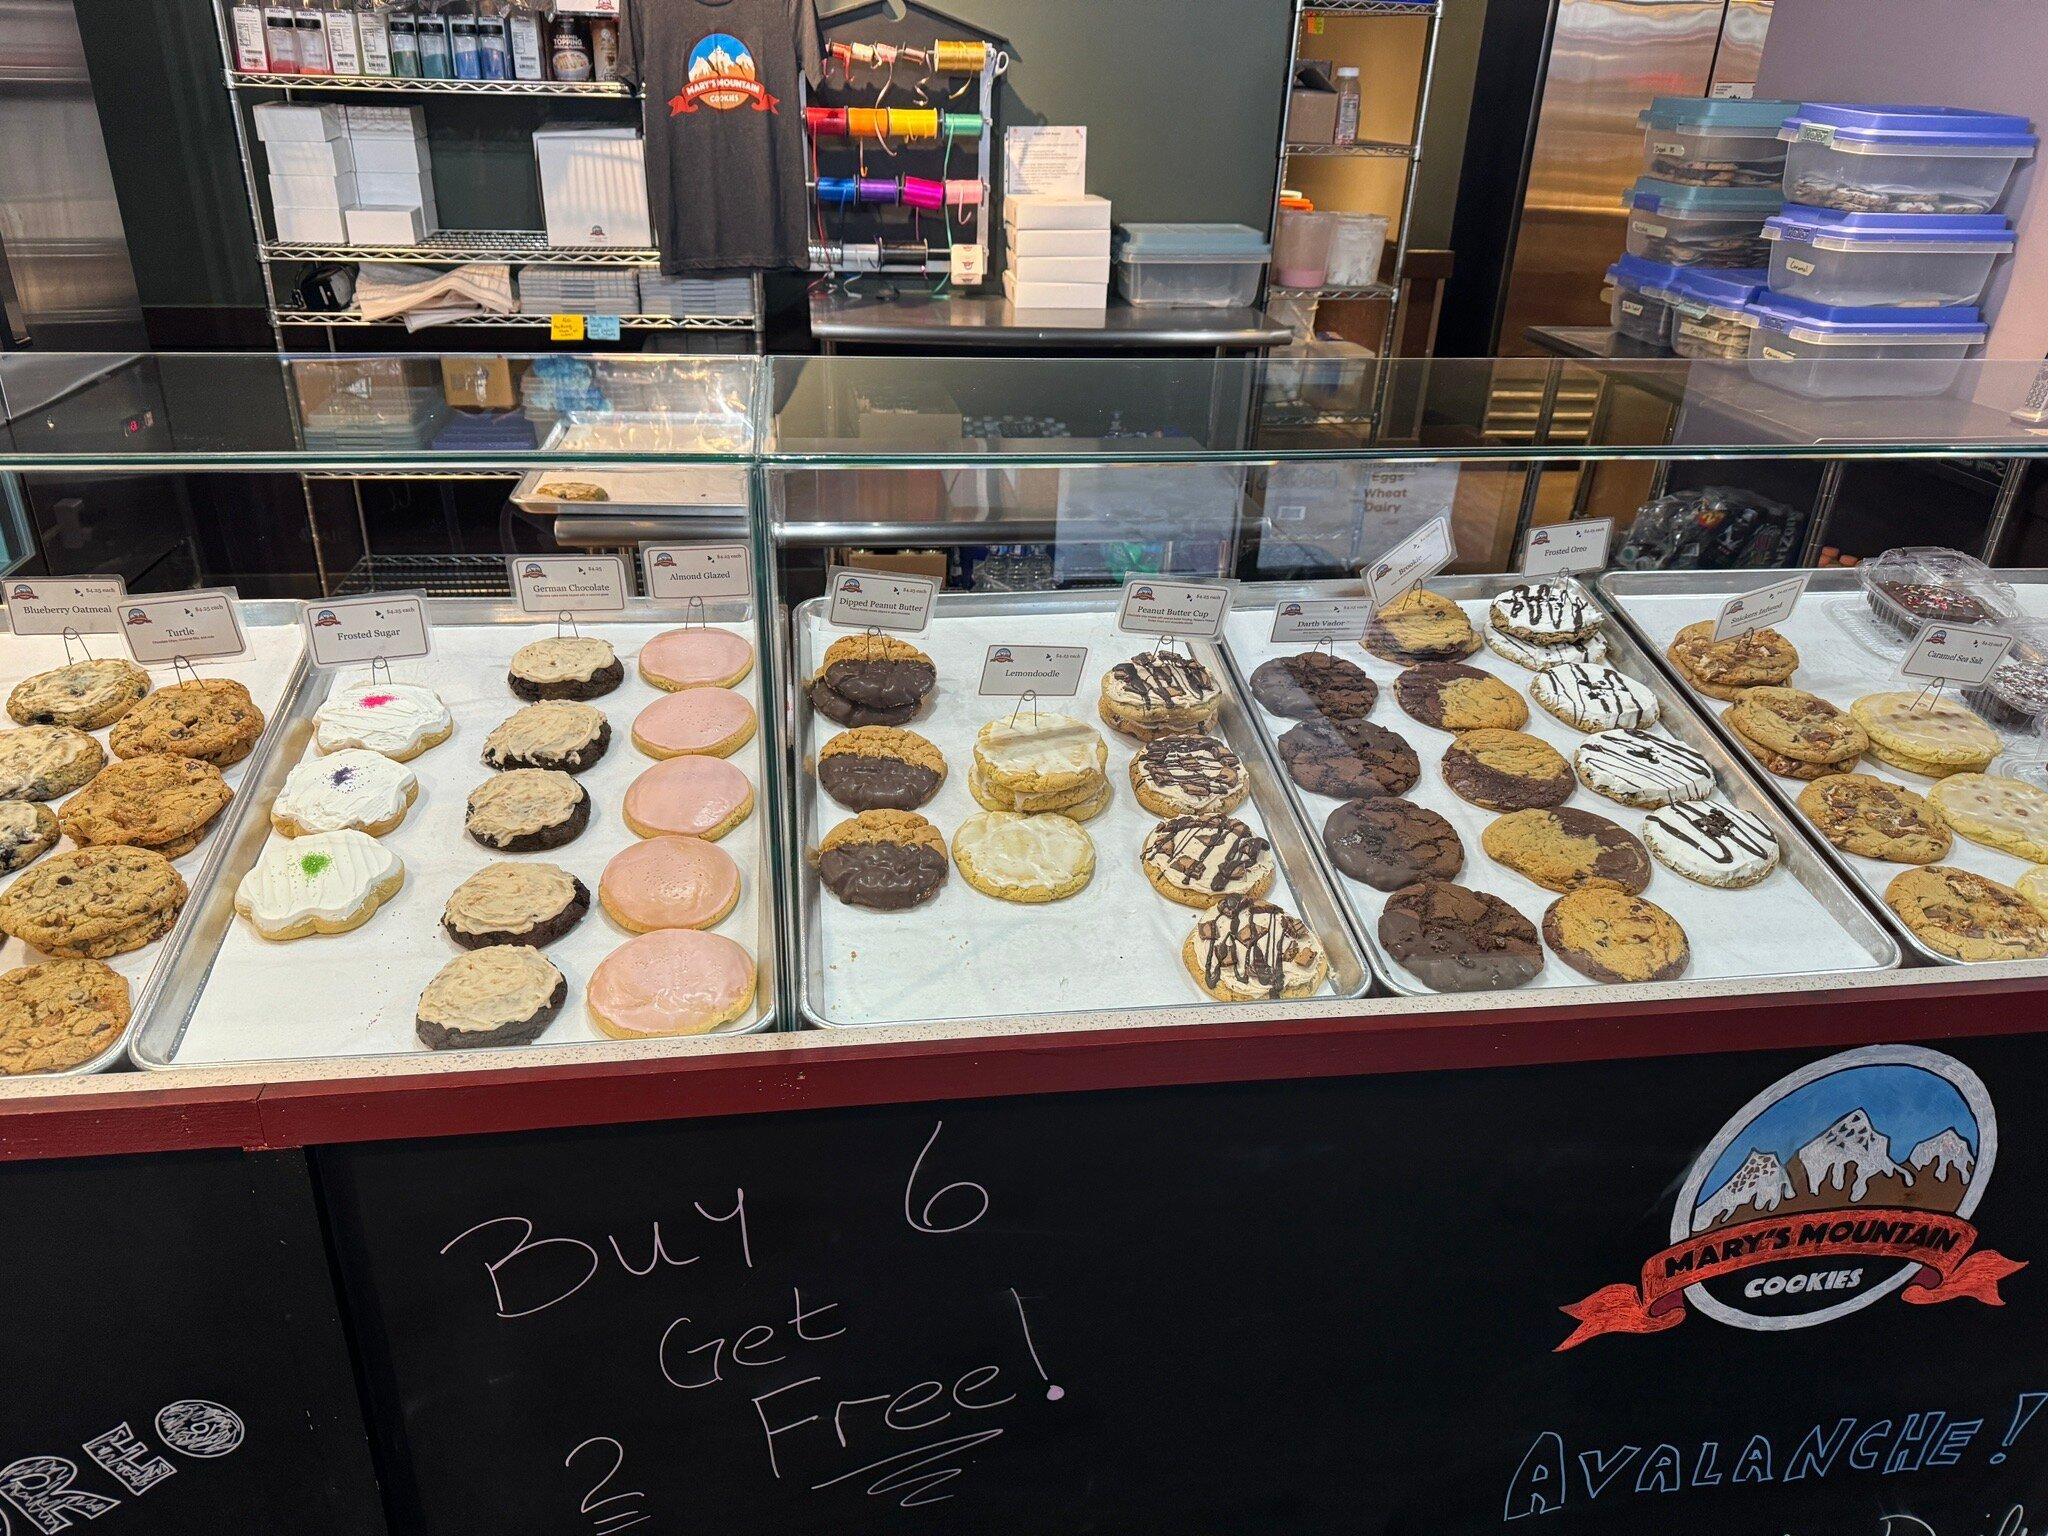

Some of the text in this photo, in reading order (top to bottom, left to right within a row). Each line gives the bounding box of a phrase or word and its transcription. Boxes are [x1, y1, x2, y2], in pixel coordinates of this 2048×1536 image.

[553, 38, 583, 46] TOPPING
[686, 78, 760, 95] MARY'S MOUNTAIN
[709, 94, 739, 103] COOKIES
[1371, 472, 1405, 484] Eggs
[1364, 488, 1408, 498] Wheat
[1365, 501, 1401, 514] Dairy
[1544, 546, 1570, 557] Frosted
[670, 571, 731, 581] Almond Glazed
[533, 583, 610, 593] German Chocolate
[23, 604, 112, 616] Blueberry Oatmeal
[840, 597, 868, 608] Dipped
[869, 600, 897, 610] Peanut
[898, 603, 923, 612] Butter
[1137, 605, 1209, 619] Peanut Butter Cup
[1730, 602, 1783, 624] Snickers Infused
[1297, 620, 1320, 628] Darth
[166, 627, 195, 638] Turtle
[337, 628, 401, 641] Frosted Sugar
[1927, 650, 1984, 665] Caramel Sea Salt
[1005, 669, 1060, 678] Lemondoodle
[441, 1120, 990, 1318] Buy 6
[1664, 1220, 1962, 1279] MARY'S MOUNTAIN
[1744, 1267, 1864, 1298] COOKIES
[660, 1287, 847, 1390] Get
[565, 1287, 1066, 1514] 2 Free!
[1503, 1392, 2048, 1522] AVALANCHE!
[0, 1399, 245, 1536] REO
